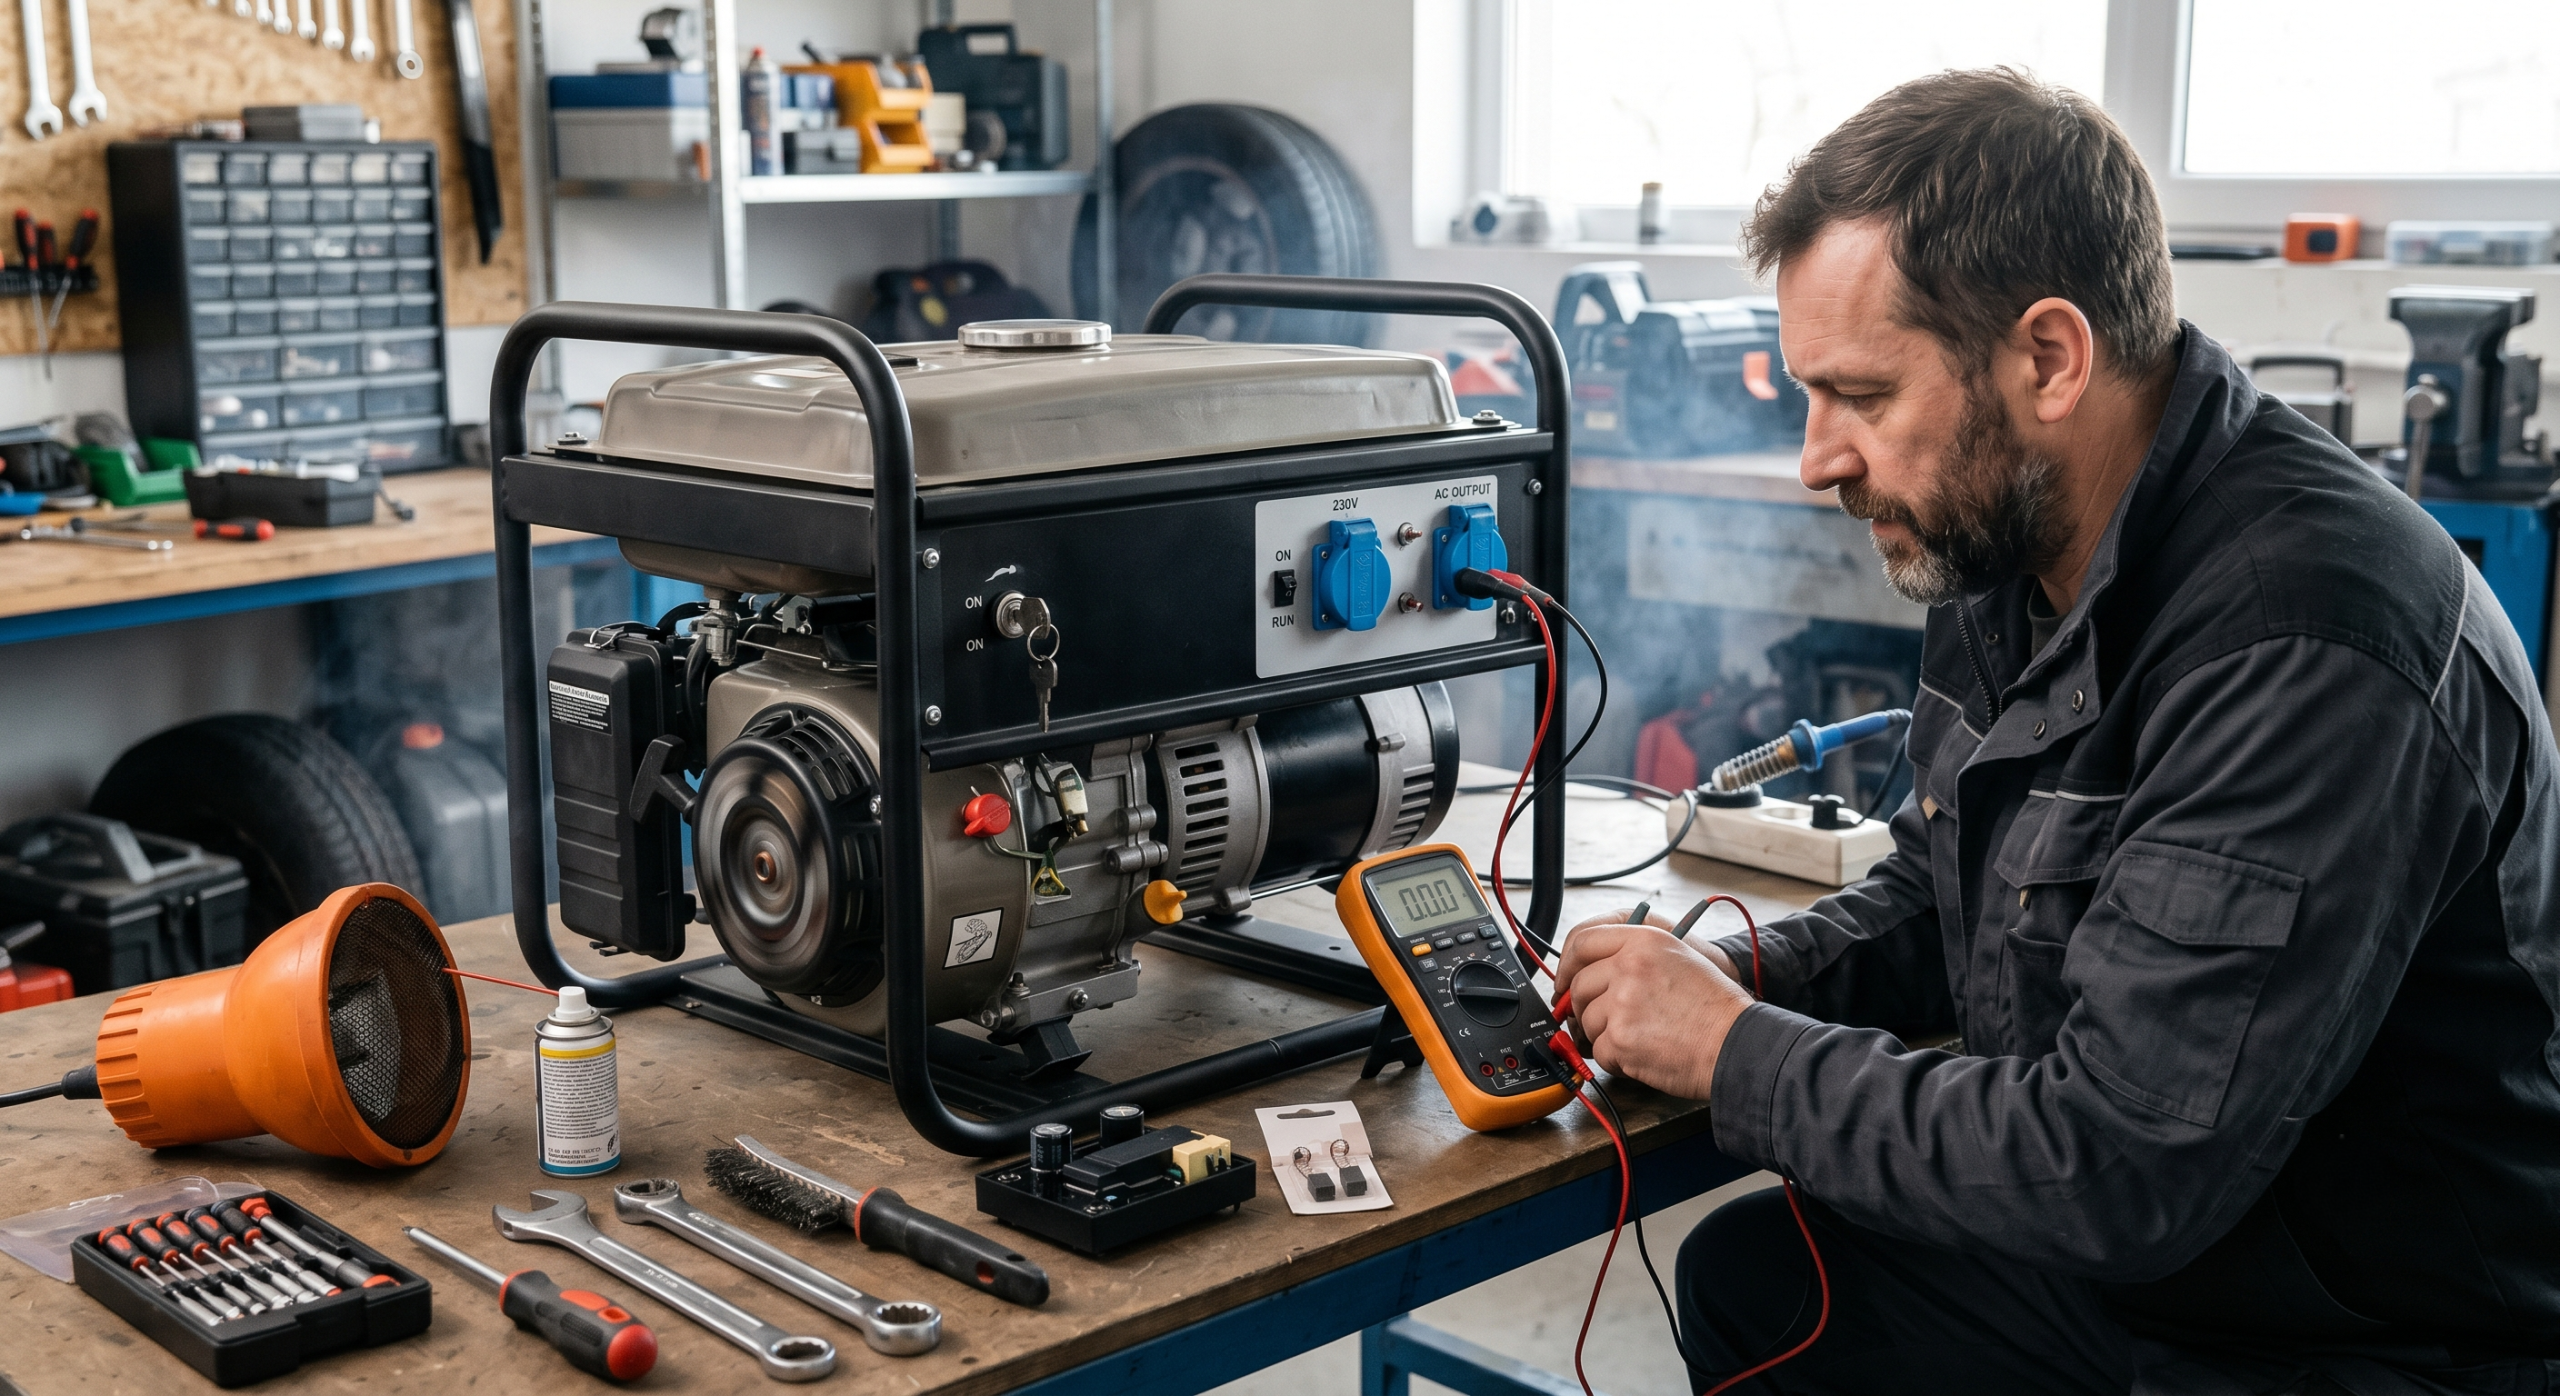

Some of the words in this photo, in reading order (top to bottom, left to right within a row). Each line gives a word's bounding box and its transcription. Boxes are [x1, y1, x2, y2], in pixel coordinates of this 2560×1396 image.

[1434, 487, 1449, 500] AC
[1451, 482, 1492, 498] OUTPUT
[1332, 497, 1359, 511] 230V
[1275, 549, 1291, 562] ON
[965, 595, 983, 609] ON
[1271, 614, 1295, 629] RUN
[966, 637, 984, 652] ON
